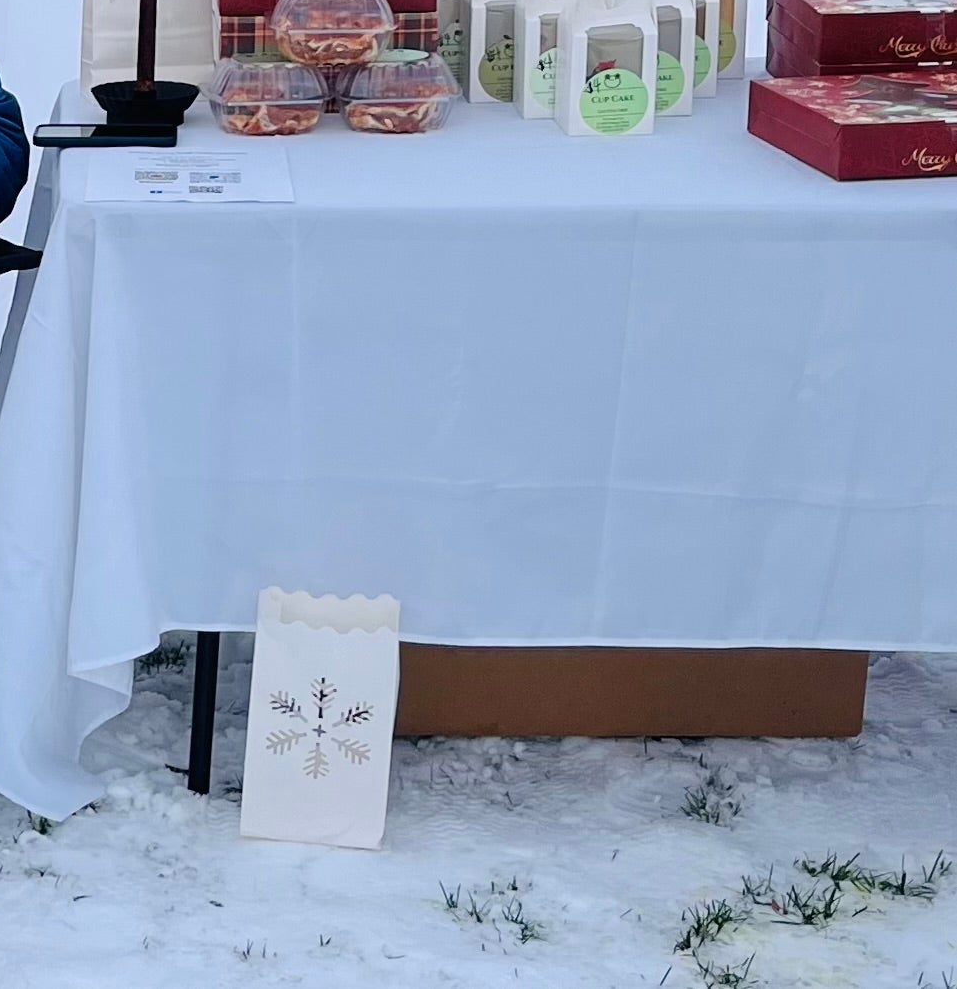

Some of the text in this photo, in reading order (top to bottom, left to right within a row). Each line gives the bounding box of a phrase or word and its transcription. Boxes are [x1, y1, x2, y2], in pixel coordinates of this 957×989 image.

[879, 36, 926, 58] Merry
[611, 94, 635, 102] CAKE
[901, 147, 950, 171] Merry
